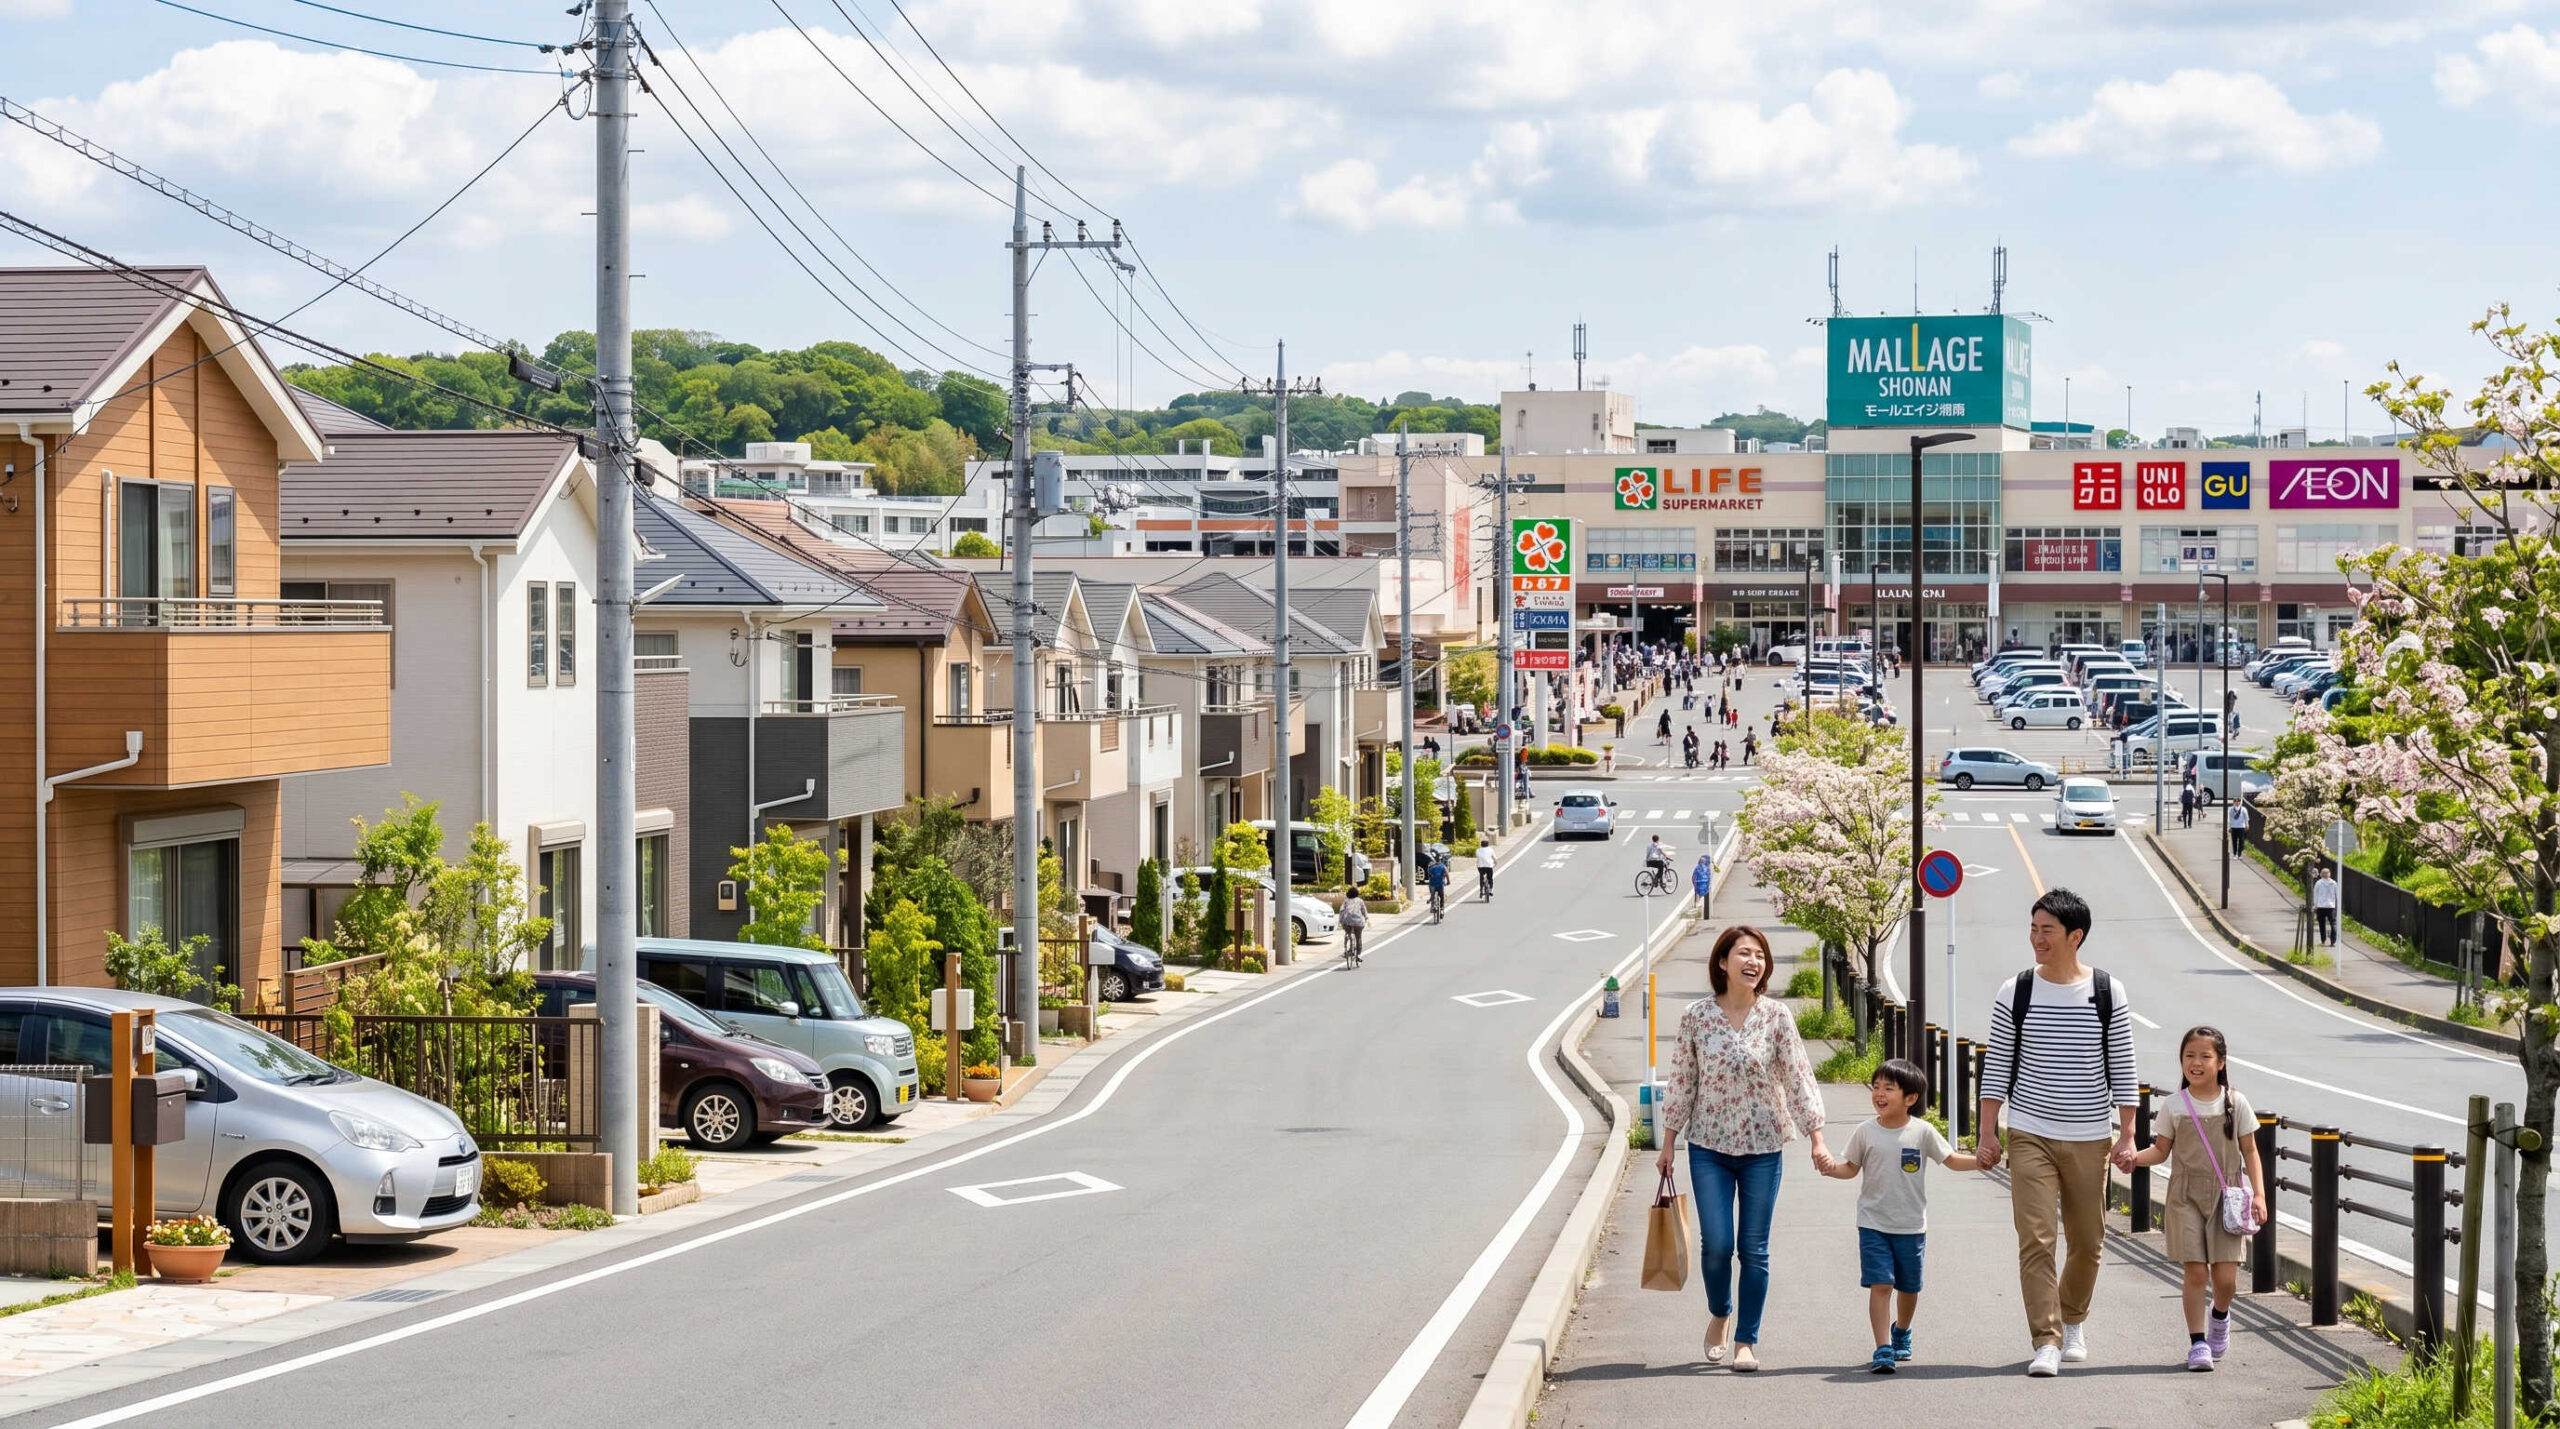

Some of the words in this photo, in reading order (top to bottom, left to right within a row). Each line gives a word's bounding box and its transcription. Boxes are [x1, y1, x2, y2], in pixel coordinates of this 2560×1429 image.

[1848, 323, 1983, 373] MALLAGE
[1879, 376, 1951, 398] SHONAN
[1663, 468, 1762, 494] LIFE
[2079, 468, 2116, 484] ユニ
[2142, 467, 2177, 484] UNI
[2204, 474, 2247, 497] GU
[1663, 498, 1763, 510] SUPERMARKET
[2079, 488, 2116, 504] クロ
[2142, 488, 2181, 506] QLO
